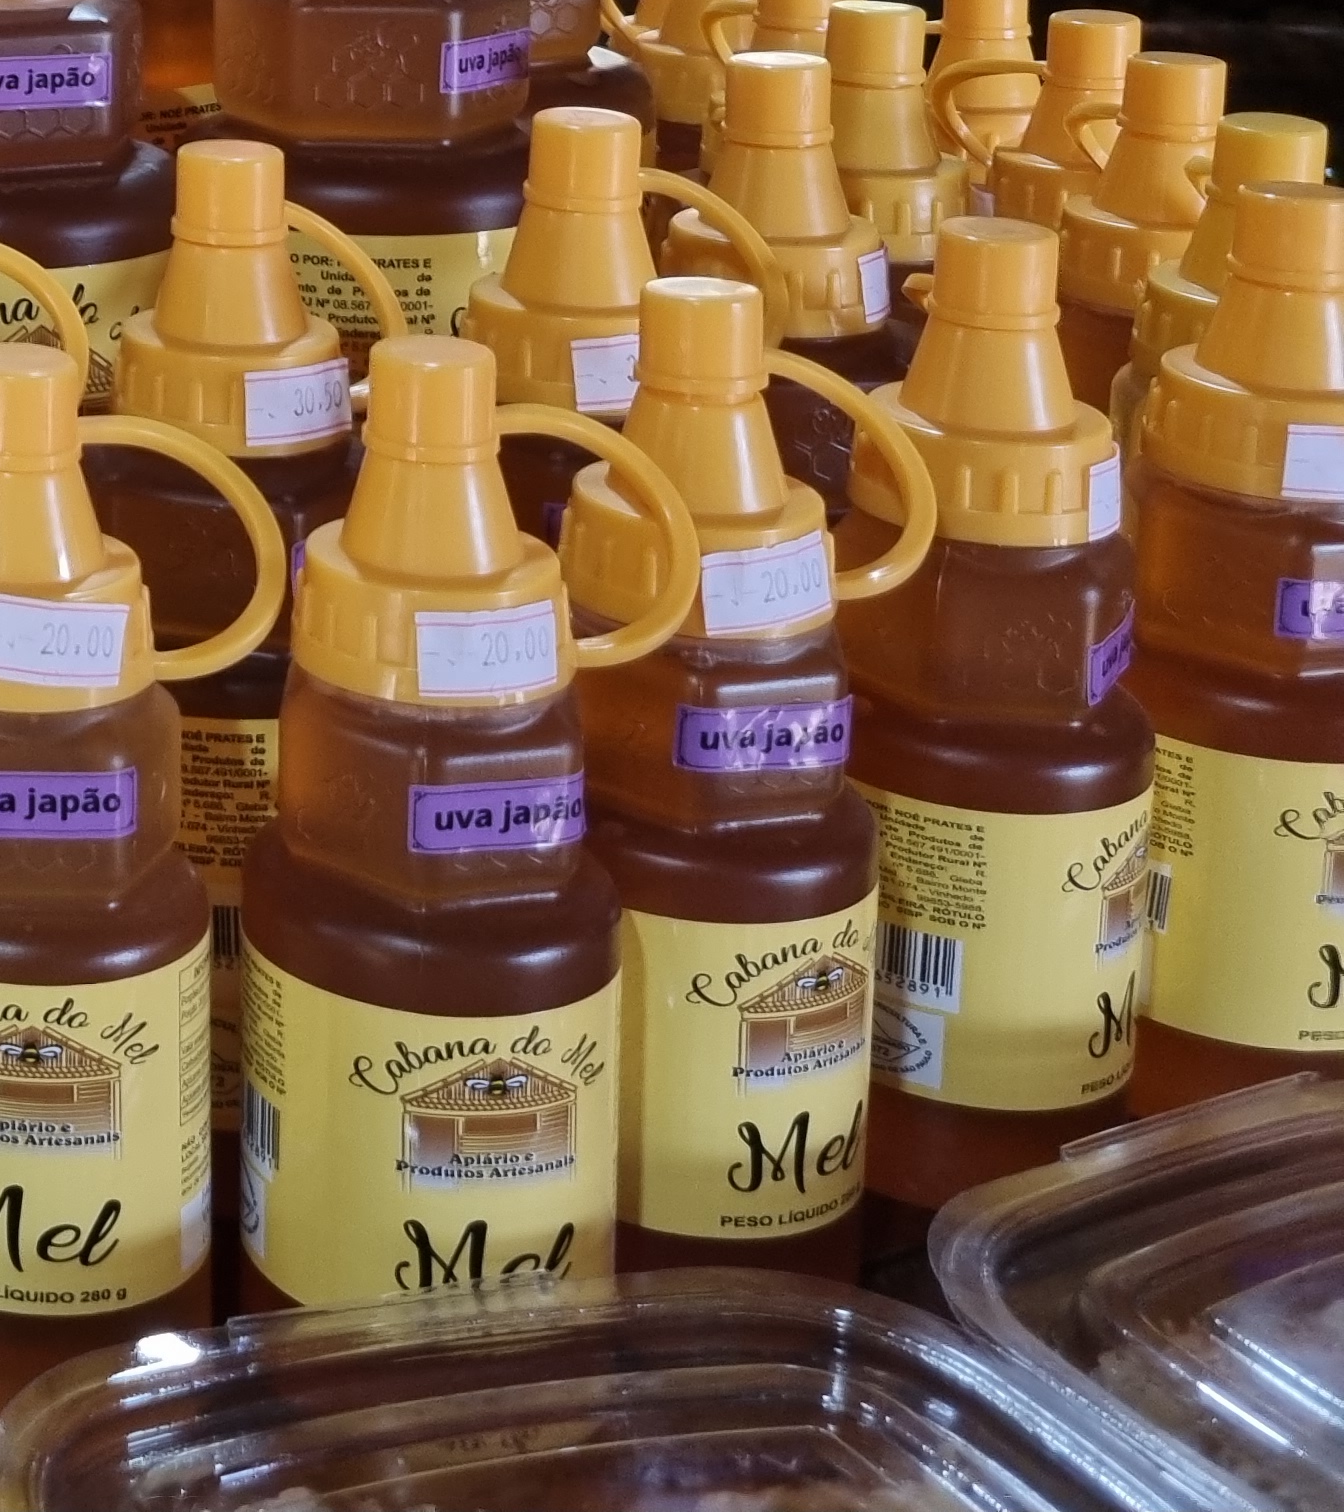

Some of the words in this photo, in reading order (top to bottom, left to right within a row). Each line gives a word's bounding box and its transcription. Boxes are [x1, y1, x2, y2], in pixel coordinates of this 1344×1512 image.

[458, 52, 485, 75] uva
[26, 66, 96, 96] japão
[416, 273, 432, 283] de
[700, 727, 756, 752] uva
[23, 784, 122, 820] japão
[434, 804, 494, 831] uva
[499, 795, 583, 835] japão
[923, 816, 973, 831] PRATES
[1061, 808, 1149, 893] Cabana
[685, 934, 824, 1009] Cabana
[832, 918, 861, 951] do
[41, 996, 91, 1030] do
[100, 1012, 161, 1067] Mel
[348, 1035, 500, 1097] Cabana
[509, 1025, 554, 1058] do
[560, 1033, 606, 1088] Mel
[780, 1041, 837, 1063] Apiário
[731, 1061, 810, 1080] Produtos
[23, 1129, 121, 1148] Artesanais
[60, 1122, 72, 1132] e
[449, 1152, 520, 1167] Apiário
[524, 1151, 535, 1163] e
[726, 1099, 865, 1195] Mel
[395, 1158, 484, 1180] Produtos
[488, 1152, 576, 1181] Artesanais
[719, 1213, 773, 1229] PESO
[777, 1196, 840, 1225] LÍQUIDO
[79, 1289, 111, 1304] 280
[116, 1286, 128, 1302] g
